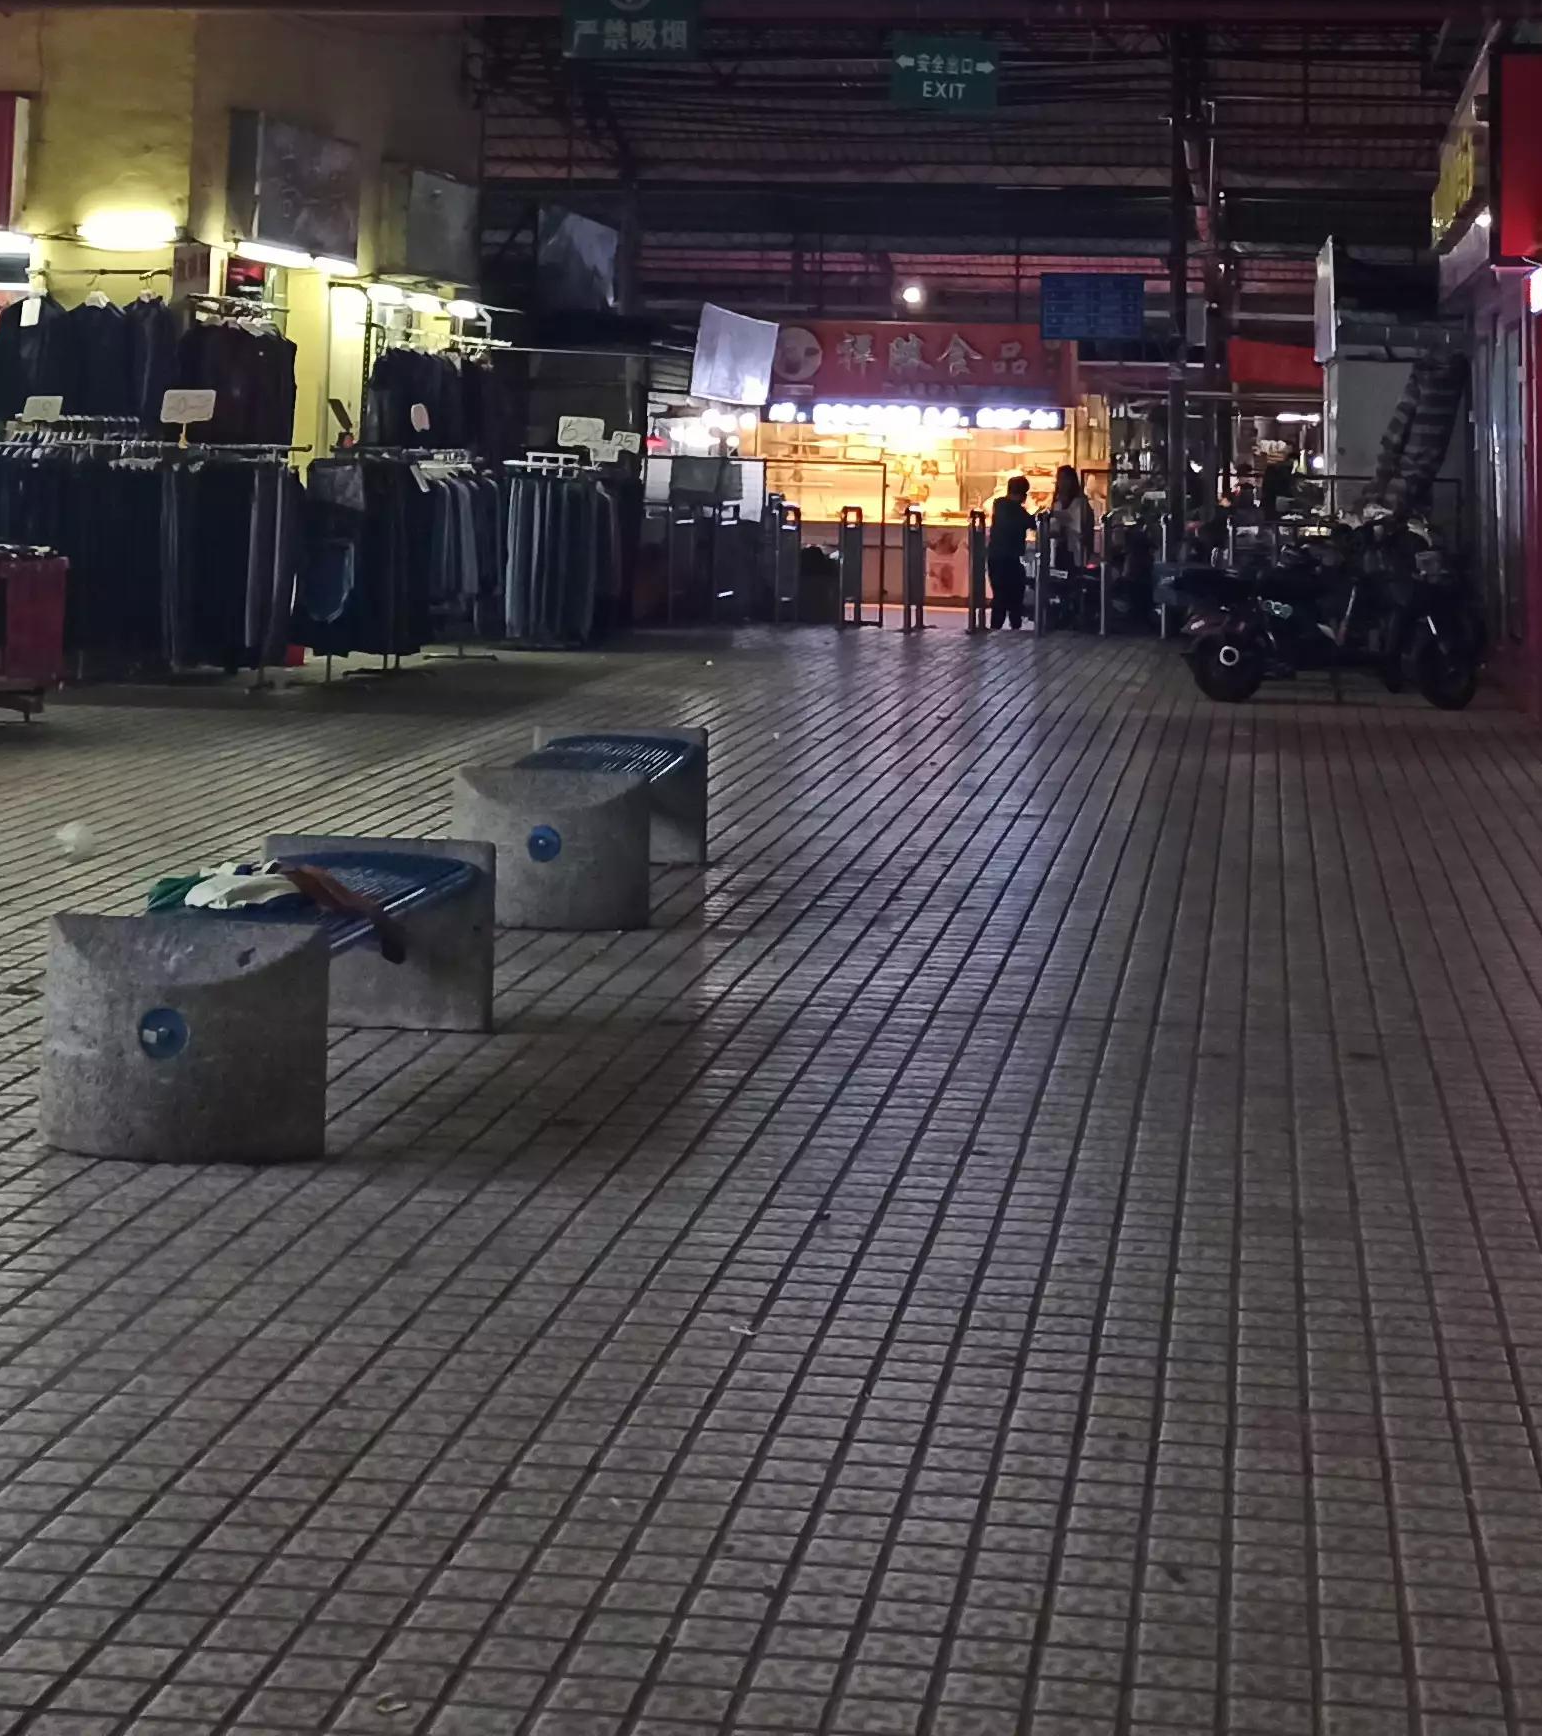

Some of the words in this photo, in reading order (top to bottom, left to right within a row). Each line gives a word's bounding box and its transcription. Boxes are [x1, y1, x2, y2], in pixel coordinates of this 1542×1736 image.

[572, 19, 688, 51] 严禁吸烟
[916, 53, 973, 74] 安全出口
[923, 81, 966, 100] EXIT
